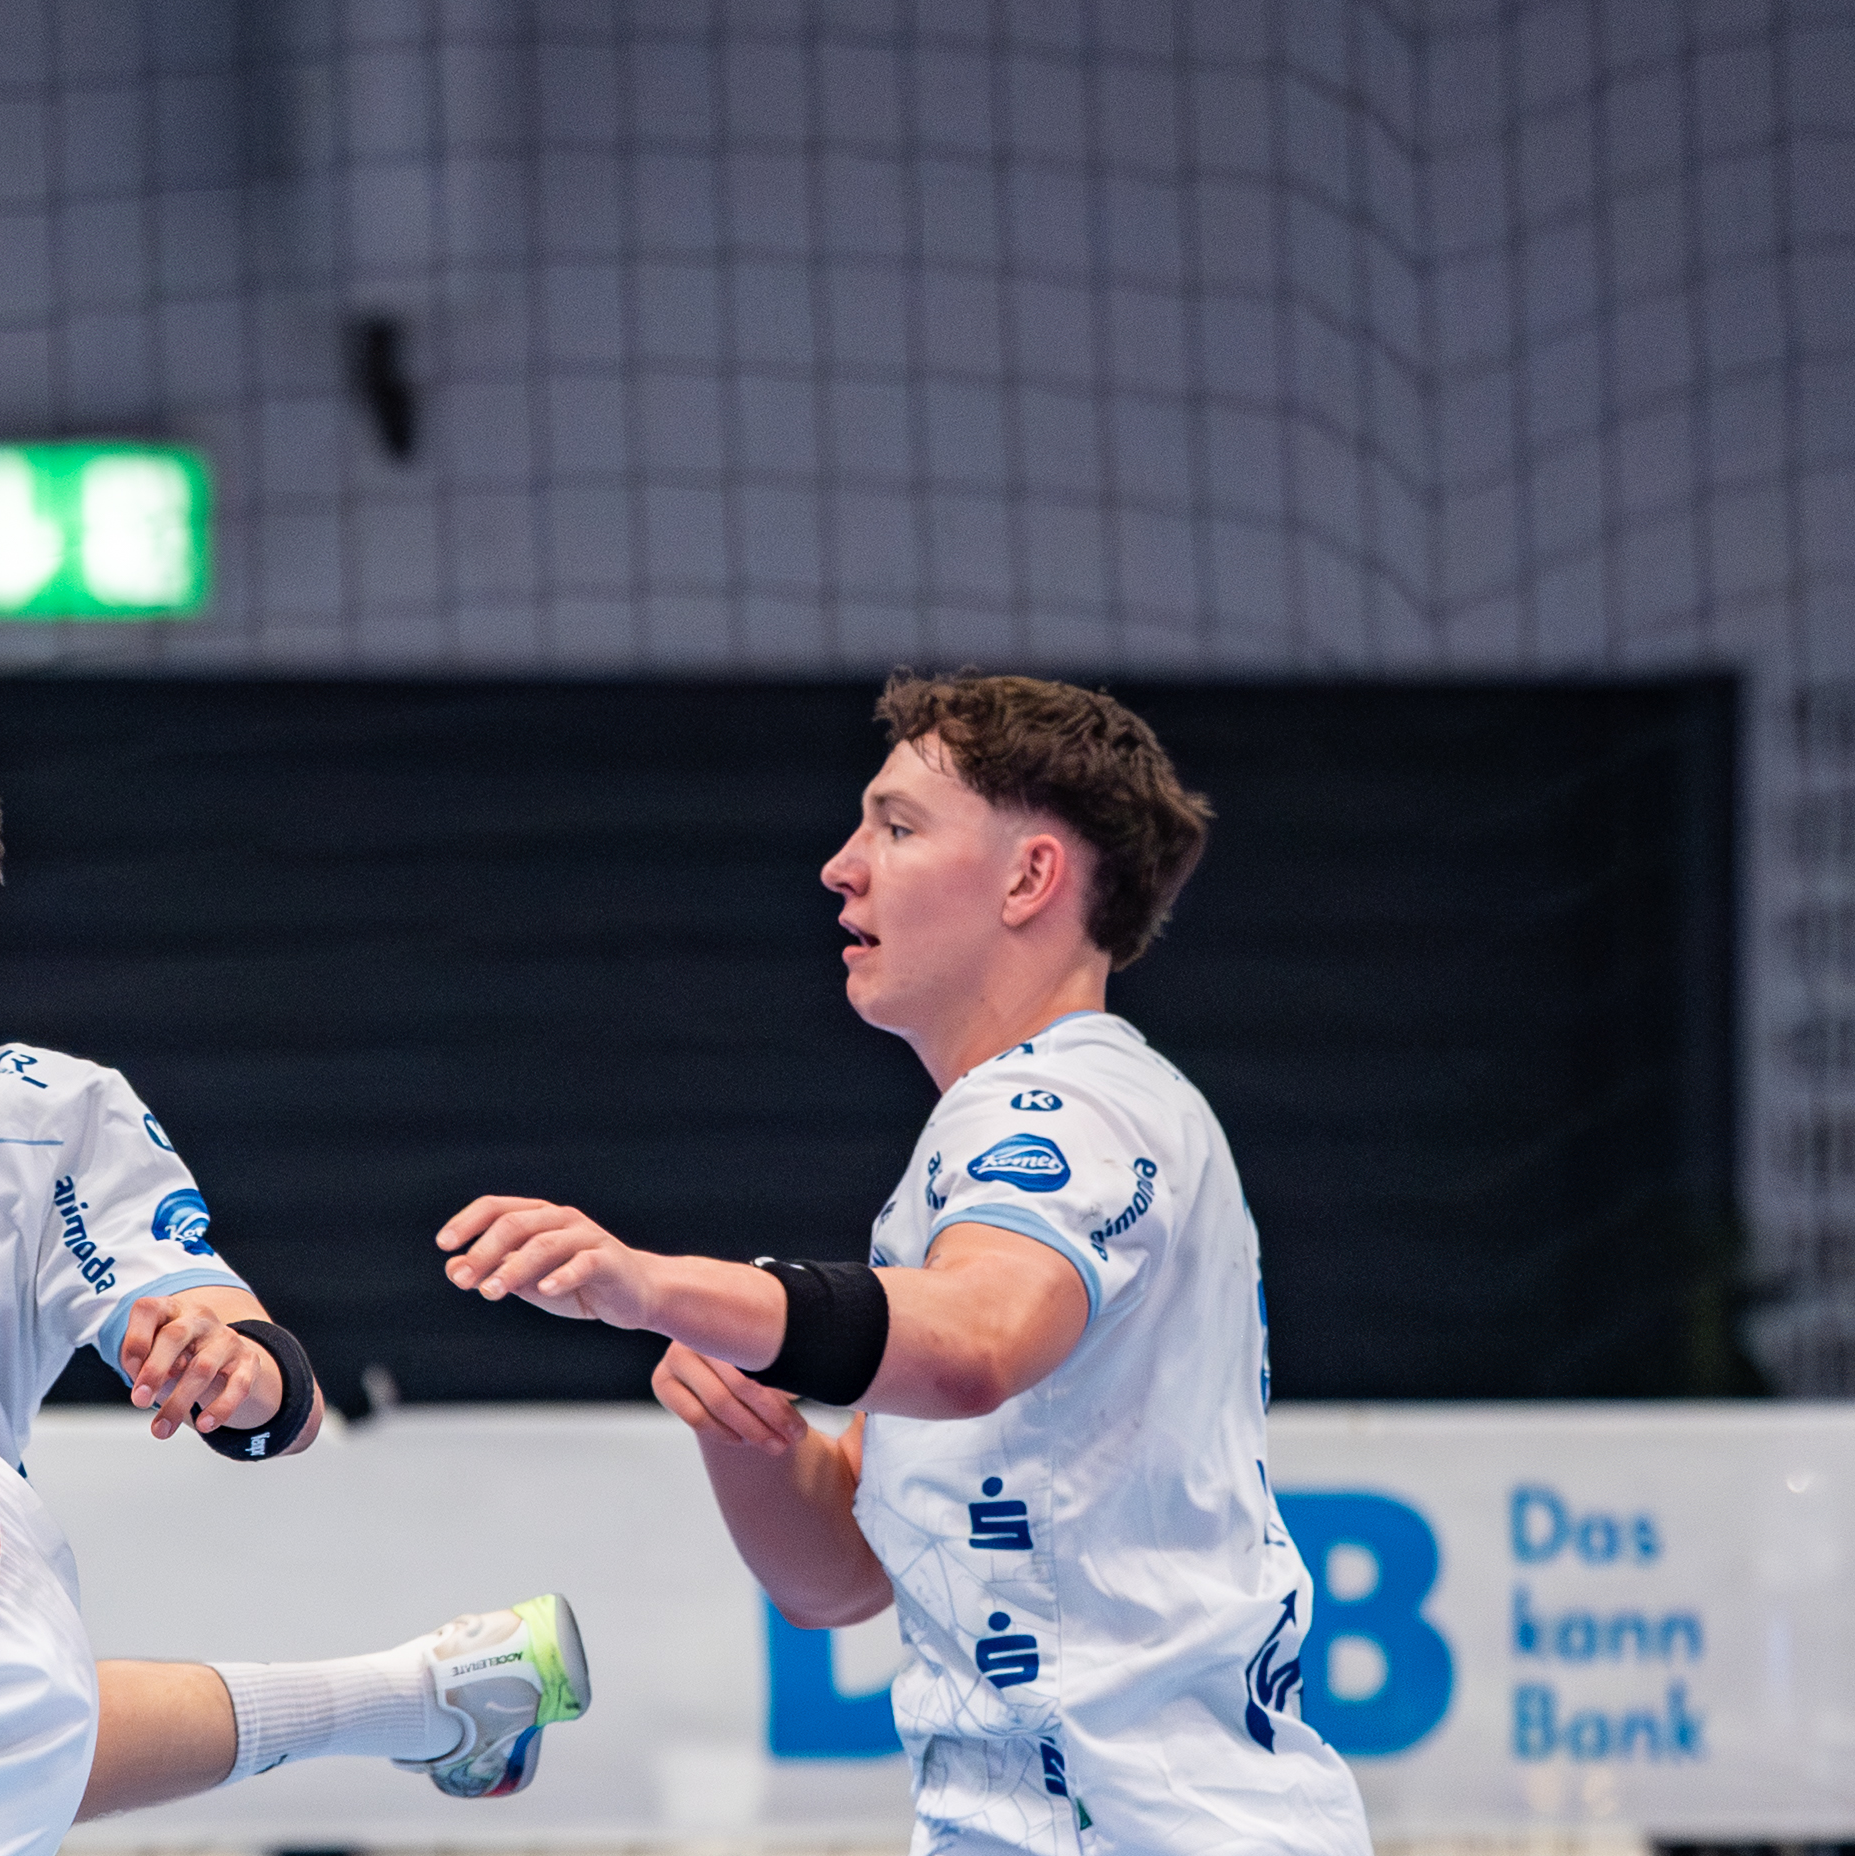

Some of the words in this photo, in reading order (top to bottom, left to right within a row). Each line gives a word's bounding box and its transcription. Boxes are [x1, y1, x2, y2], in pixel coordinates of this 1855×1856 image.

[1506, 1482, 1663, 1566] Das
[1509, 1582, 1705, 1662] kann
[1509, 1680, 1707, 1762] Bank
